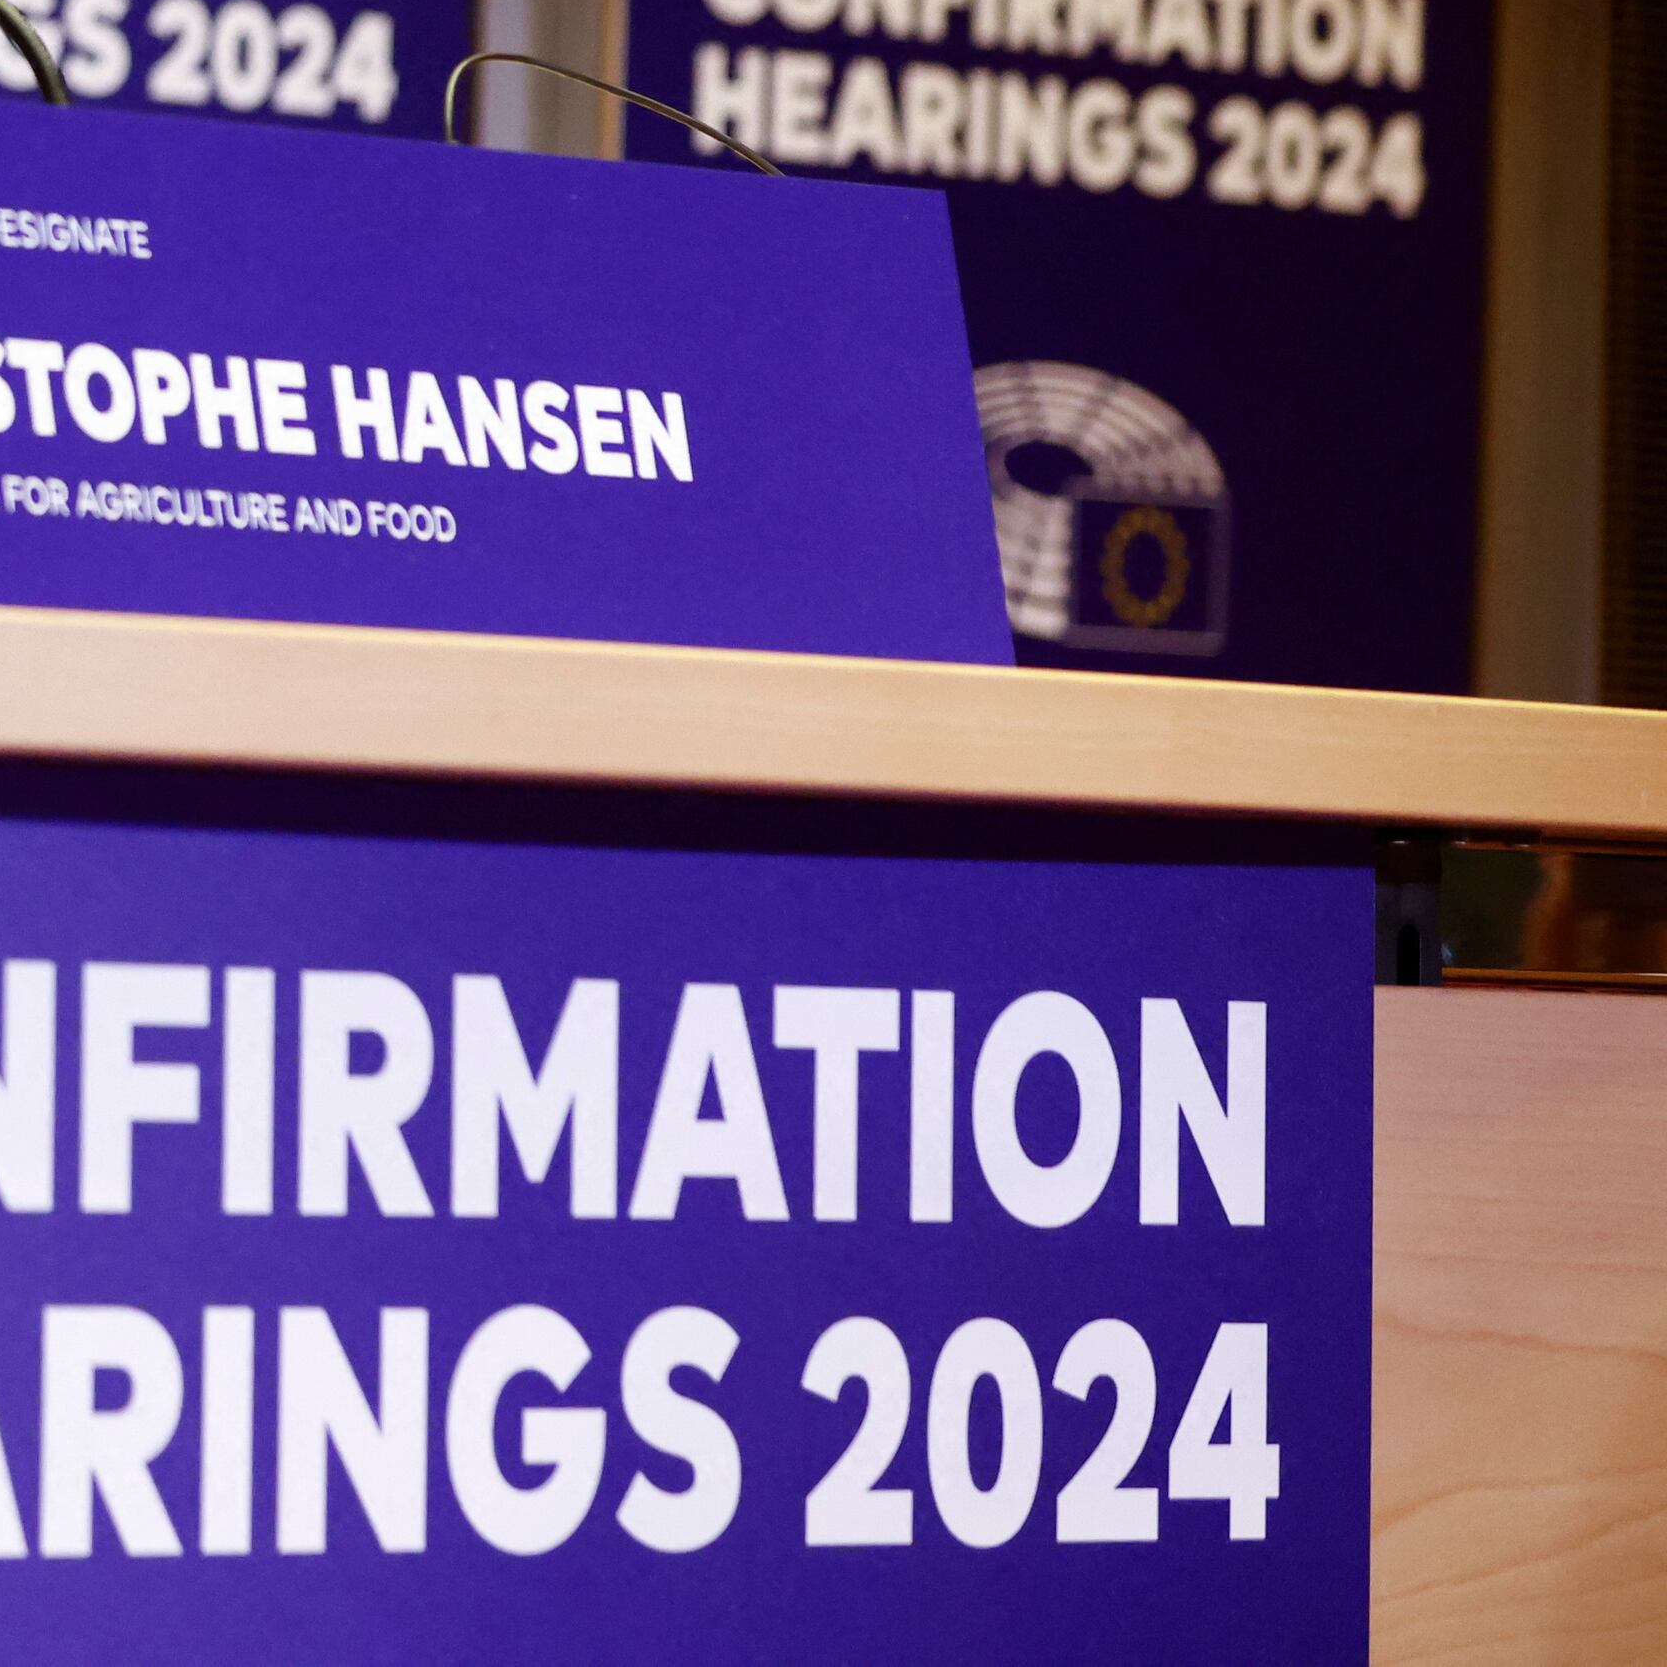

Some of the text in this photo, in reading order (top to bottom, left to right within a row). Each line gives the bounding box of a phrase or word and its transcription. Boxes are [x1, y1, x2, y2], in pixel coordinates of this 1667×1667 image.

[690, 42, 1425, 218] HEARINGS 2024
[329, 363, 695, 484] HANSEN
[0, 473, 72, 518] FOR
[74, 479, 291, 534] AGRICULTURE
[293, 495, 364, 538] AND
[365, 499, 458, 544] FOOD
[800, 1315, 1281, 1550] 2024
